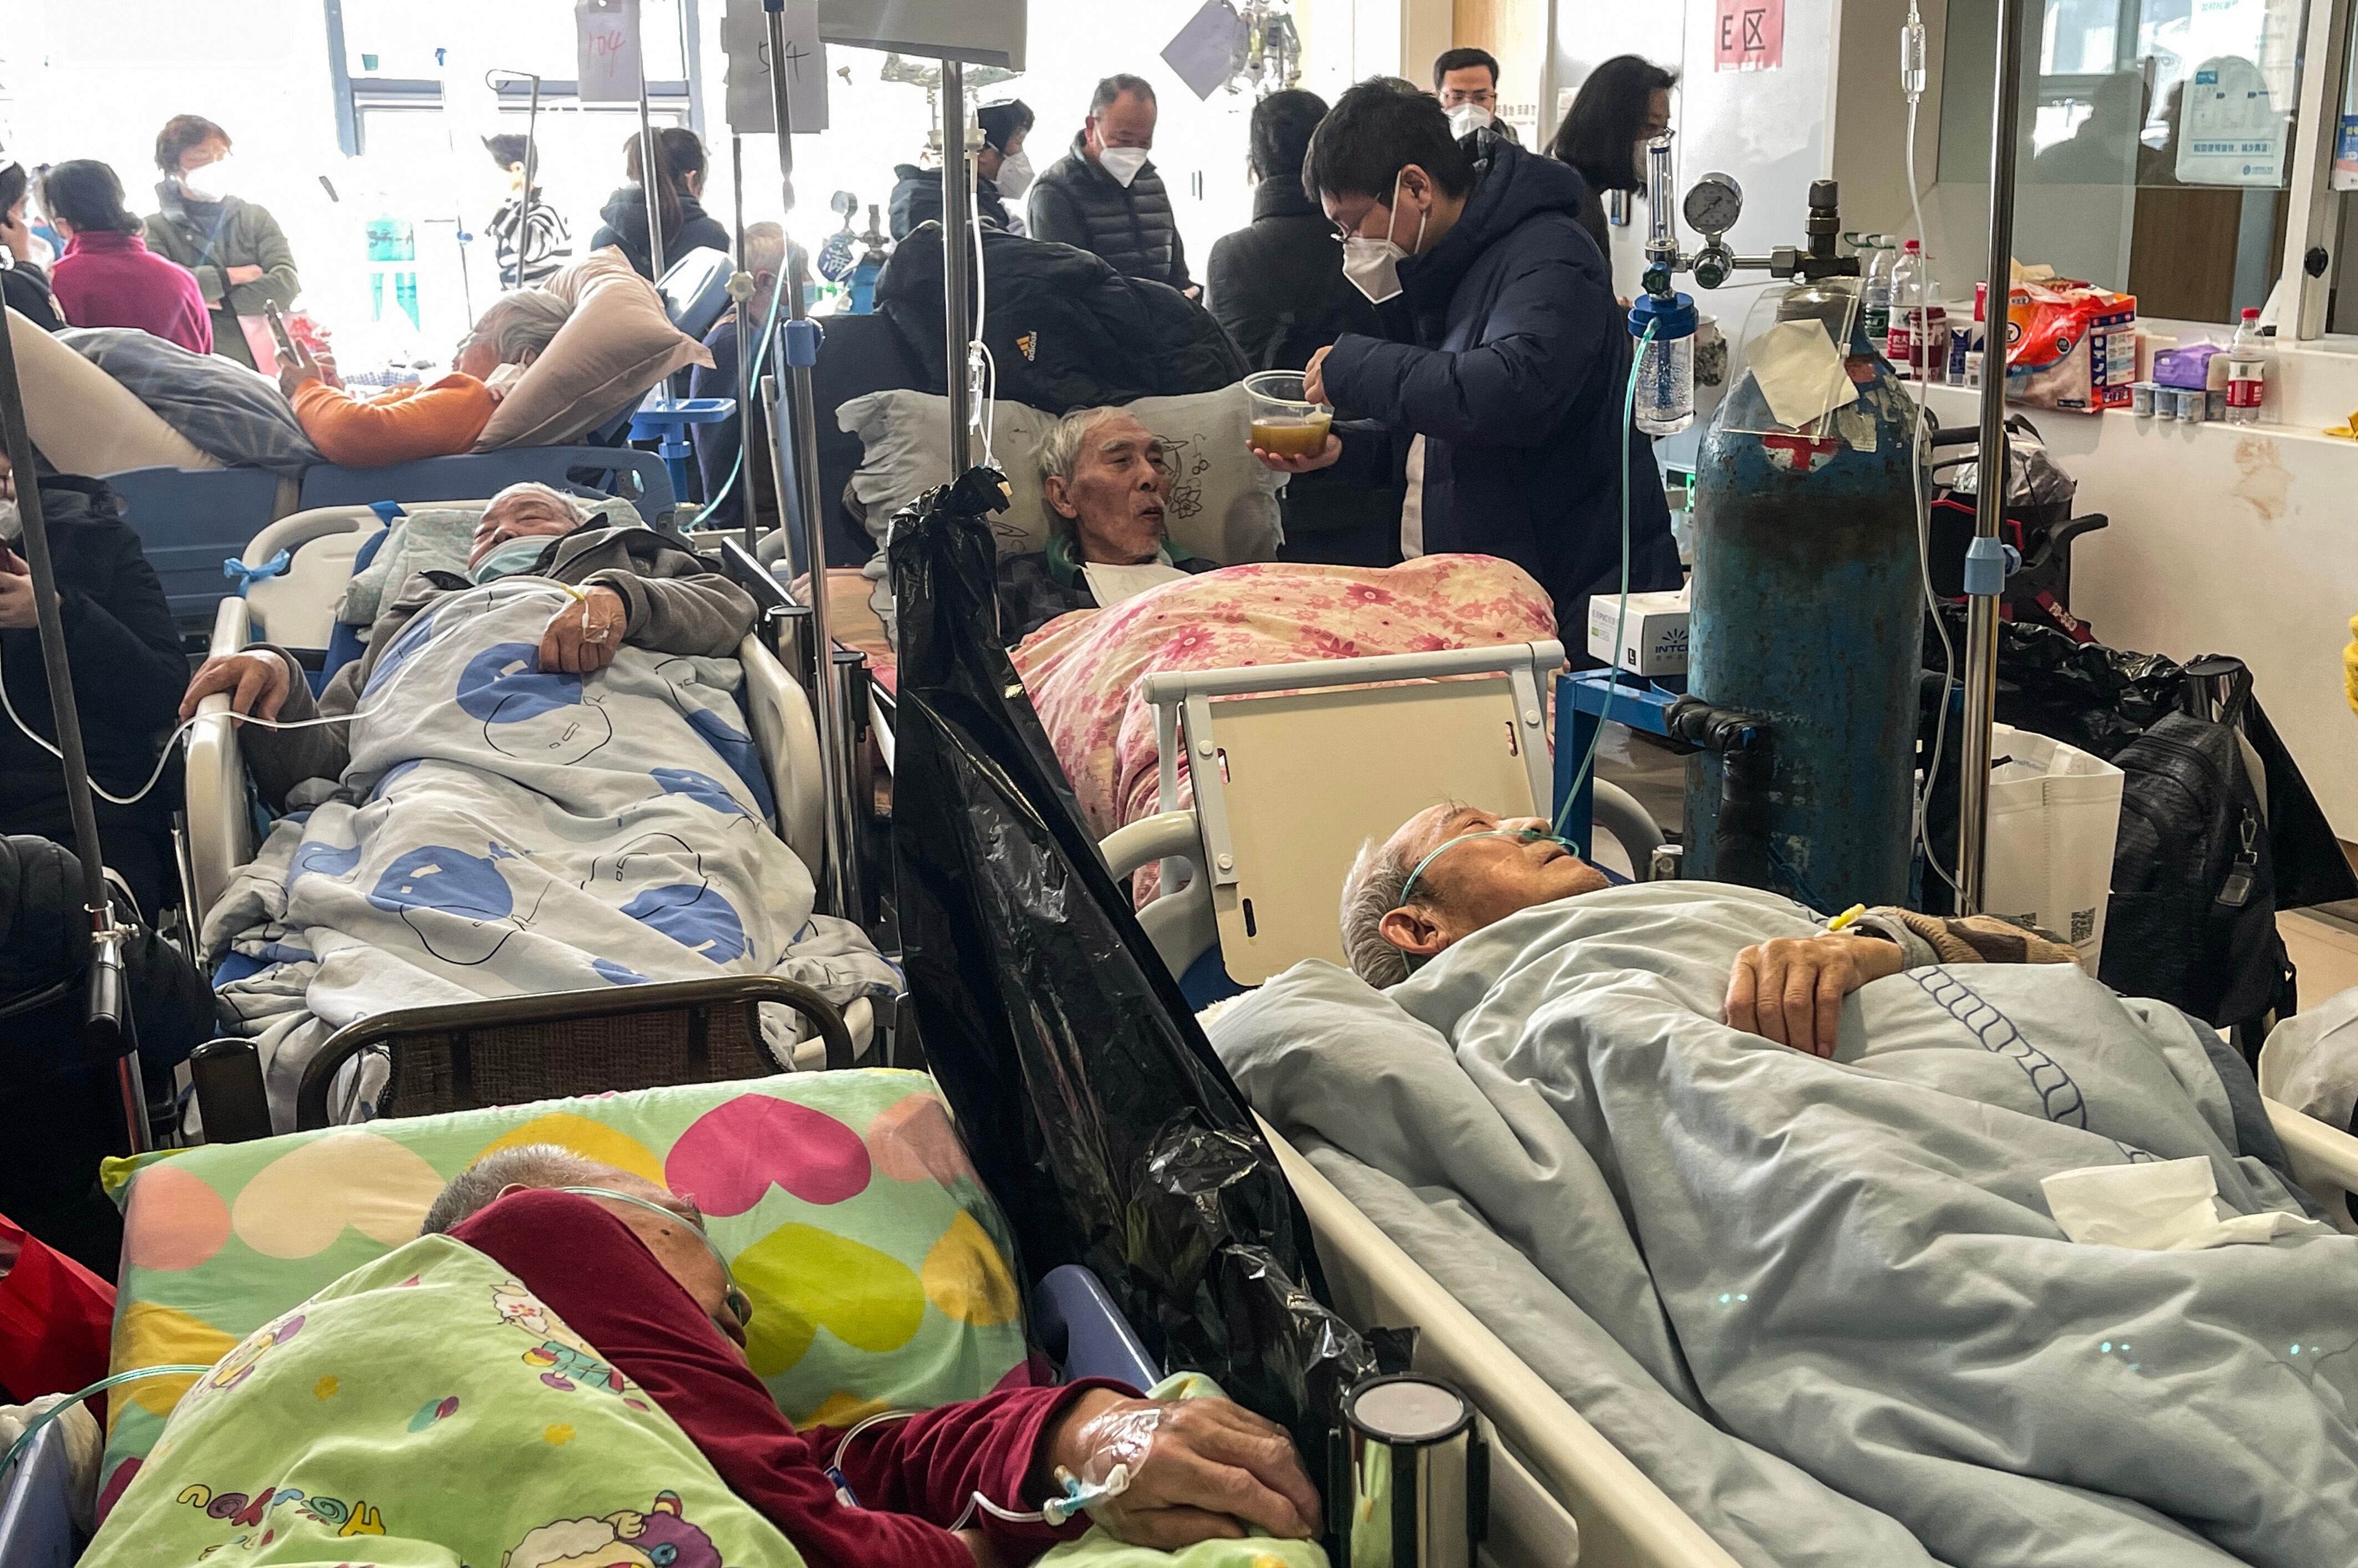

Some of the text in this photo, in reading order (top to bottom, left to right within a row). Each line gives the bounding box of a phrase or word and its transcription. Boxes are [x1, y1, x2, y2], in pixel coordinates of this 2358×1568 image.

[1722, 8, 1766, 51] E区
[588, 30, 626, 78] 104
[1028, 330, 1037, 361] adidas
